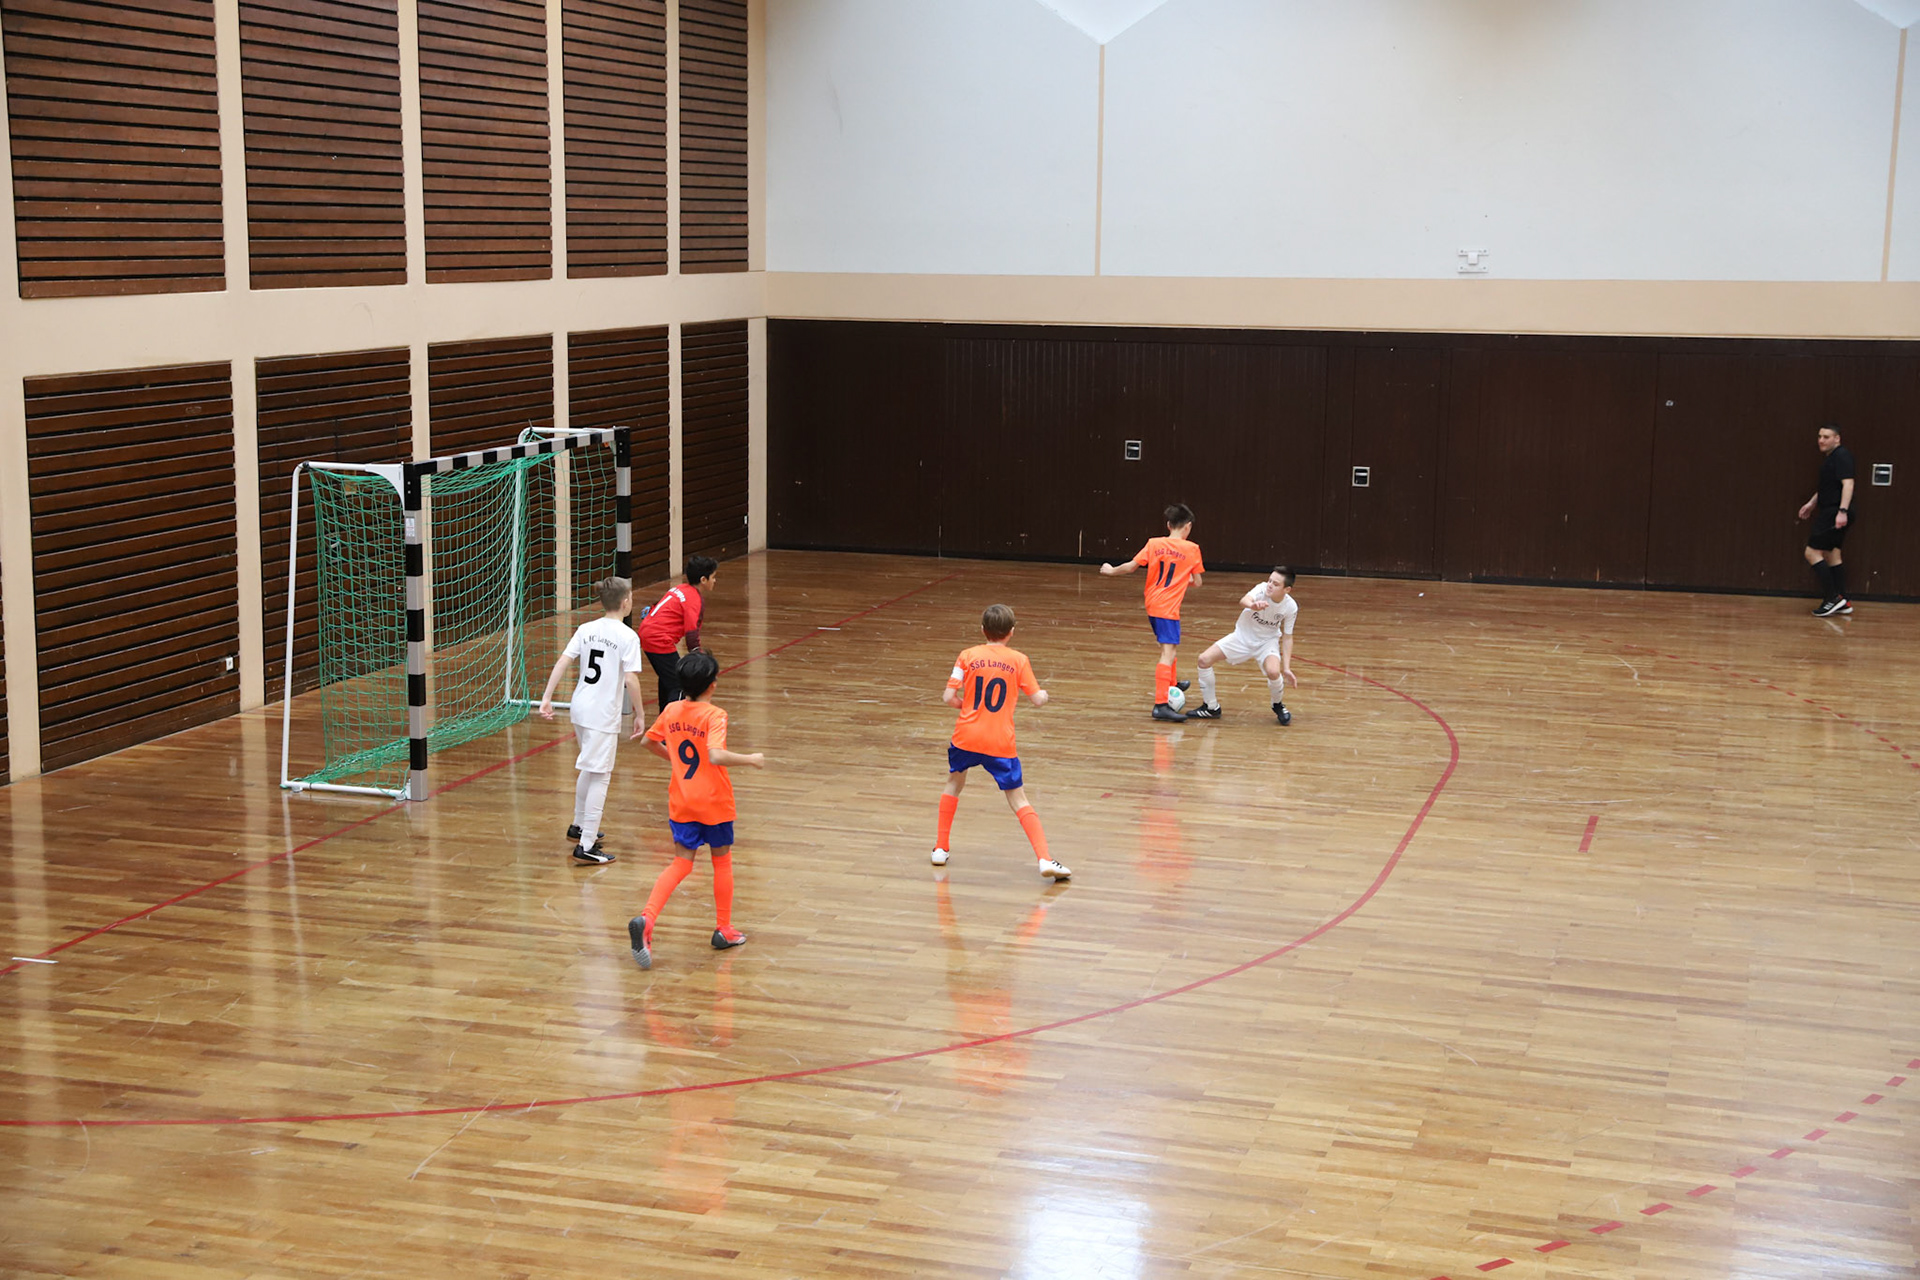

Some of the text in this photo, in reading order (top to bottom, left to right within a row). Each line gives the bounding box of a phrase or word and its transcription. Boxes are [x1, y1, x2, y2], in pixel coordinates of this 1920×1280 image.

[1156, 561, 1176, 588] 11
[584, 649, 604, 684] 5
[970, 660, 1015, 675] SSG Langen
[973, 676, 1007, 713] 10
[678, 739, 700, 780] 9
